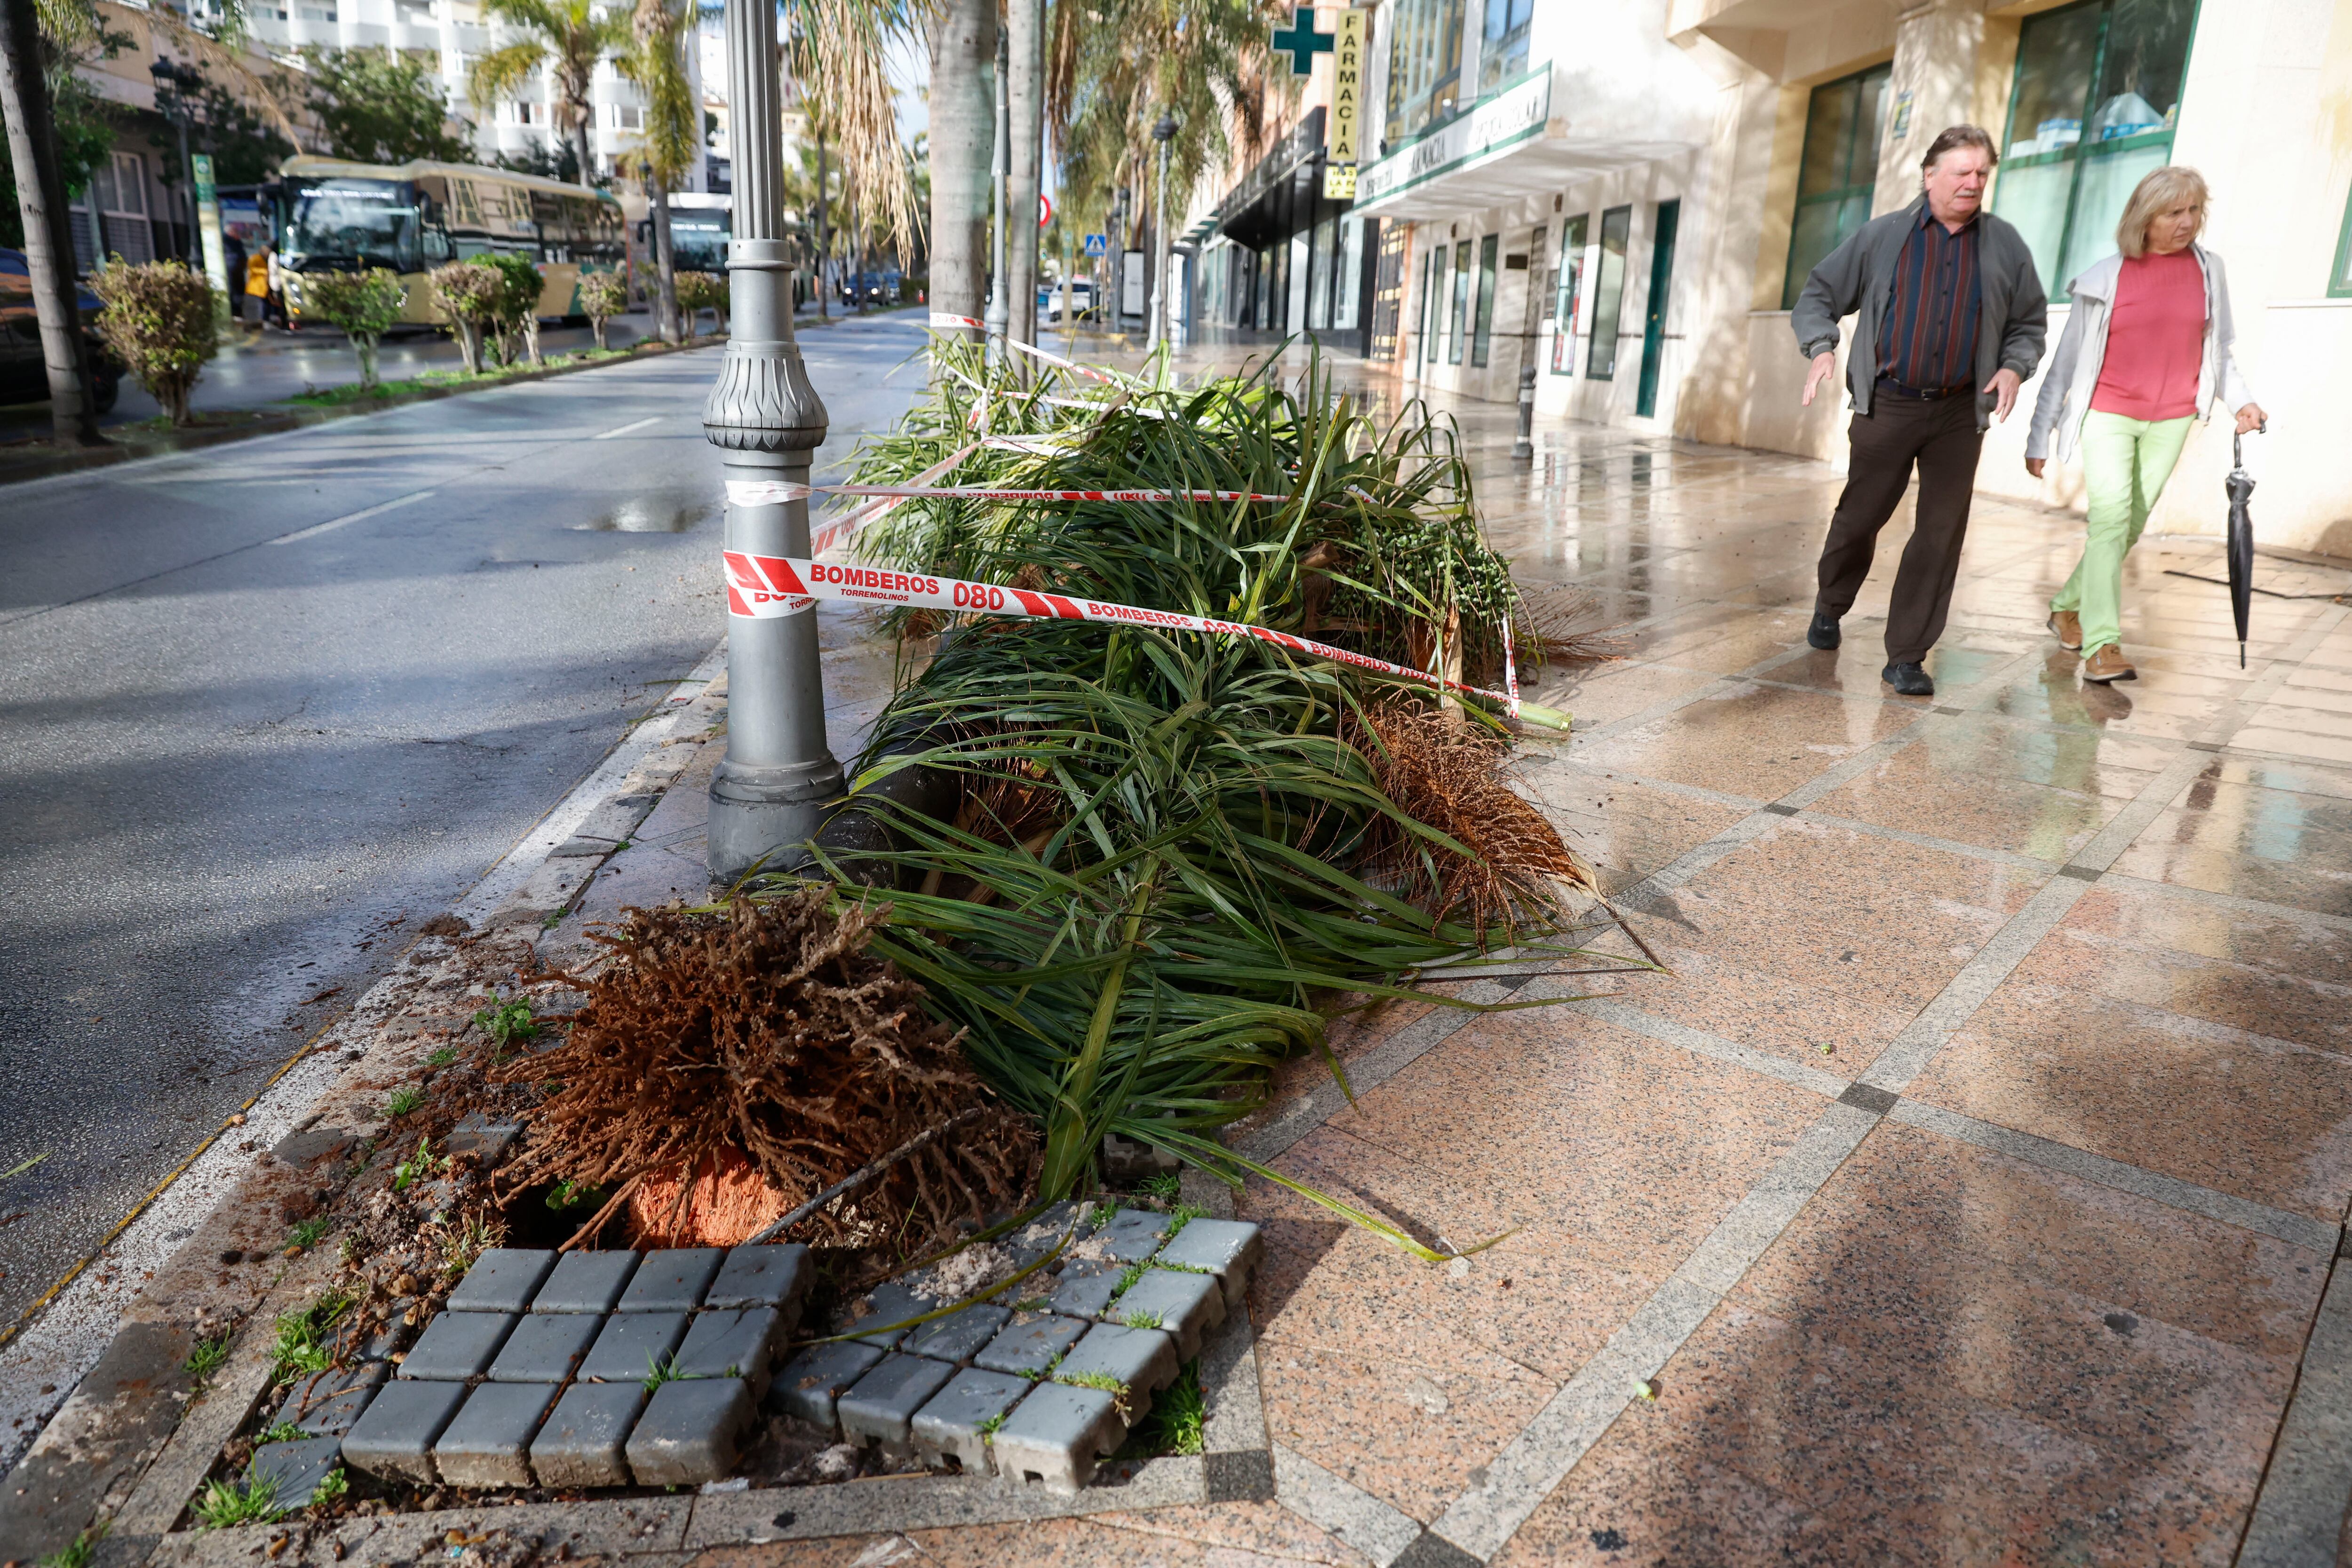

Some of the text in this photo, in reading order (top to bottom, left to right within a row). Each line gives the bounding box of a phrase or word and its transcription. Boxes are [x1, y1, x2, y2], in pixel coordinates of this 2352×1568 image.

[1336, 15, 1357, 154] FARMACIA
[810, 564, 1004, 610] BOMBEROS 080
[840, 588, 909, 602] TORREMOLINOS
[1088, 602, 1193, 627] BOMBEROS
[1309, 642, 1391, 672] BOMBEROS
